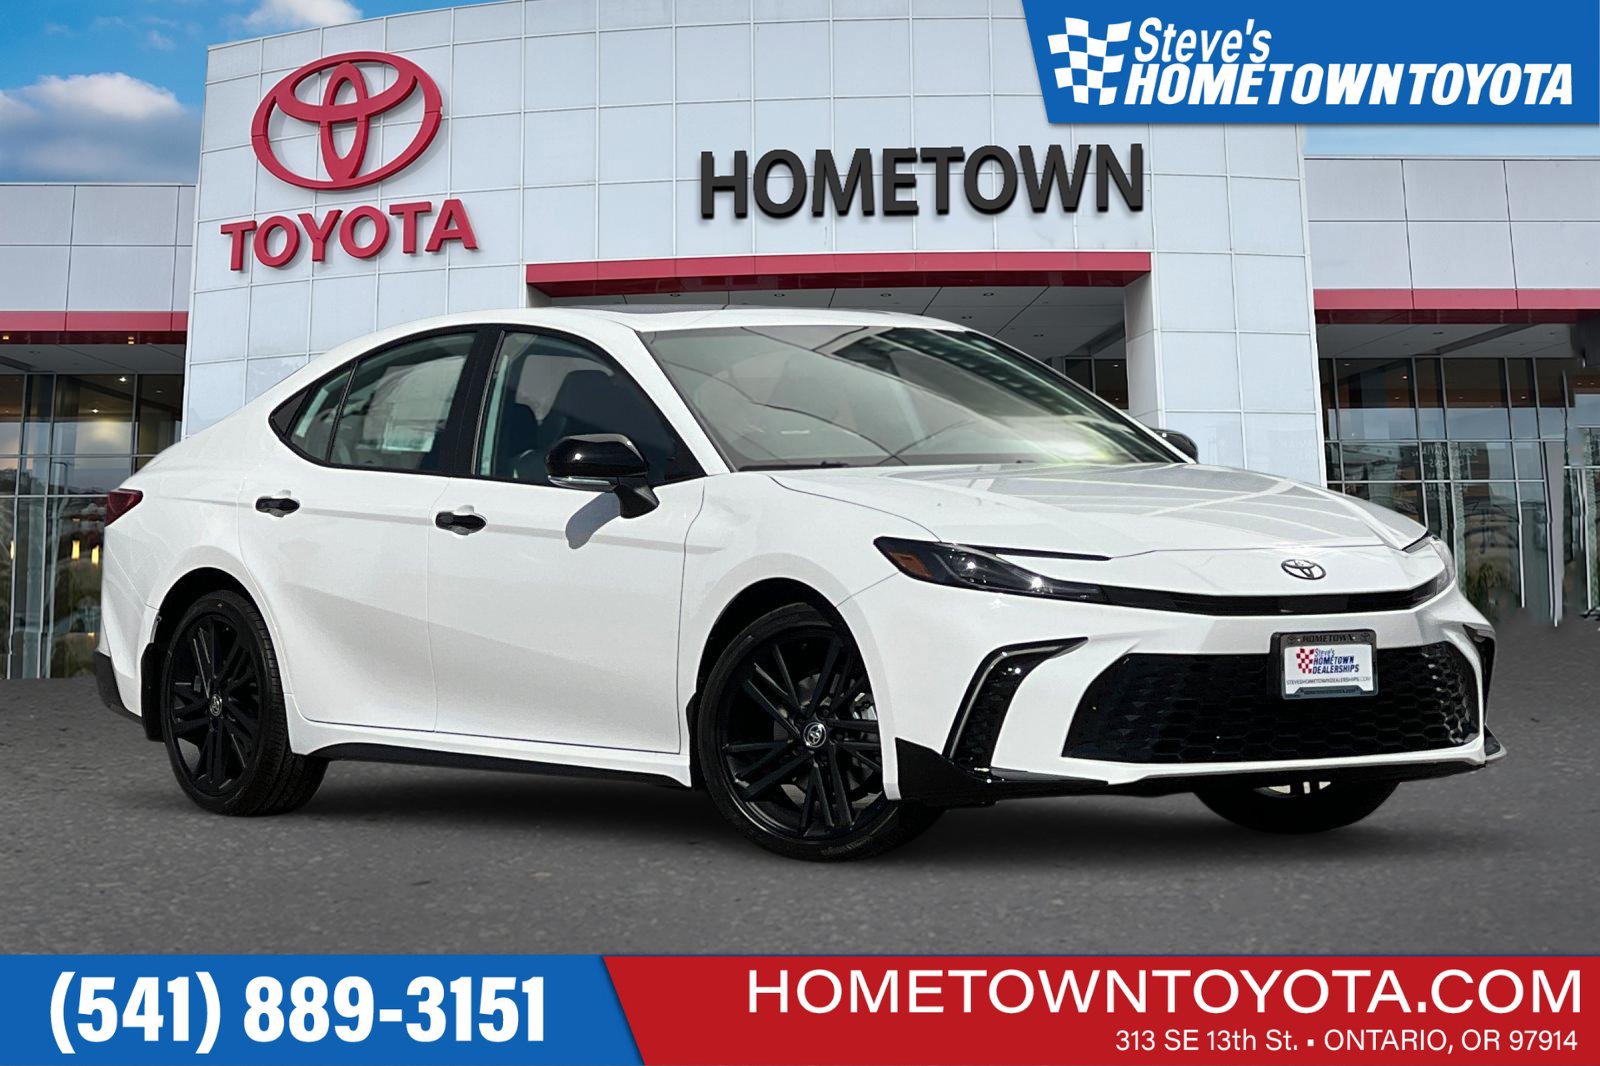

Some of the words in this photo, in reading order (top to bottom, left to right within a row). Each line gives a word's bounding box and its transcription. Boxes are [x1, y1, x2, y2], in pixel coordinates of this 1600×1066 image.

[700, 144, 1144, 219] HOMETOWN
[221, 199, 478, 271] TOYOTA
[1315, 648, 1335, 658] Steve's
[1313, 655, 1354, 665] HOMETOWN
[1312, 664, 1360, 674] DEALERSHIPS
